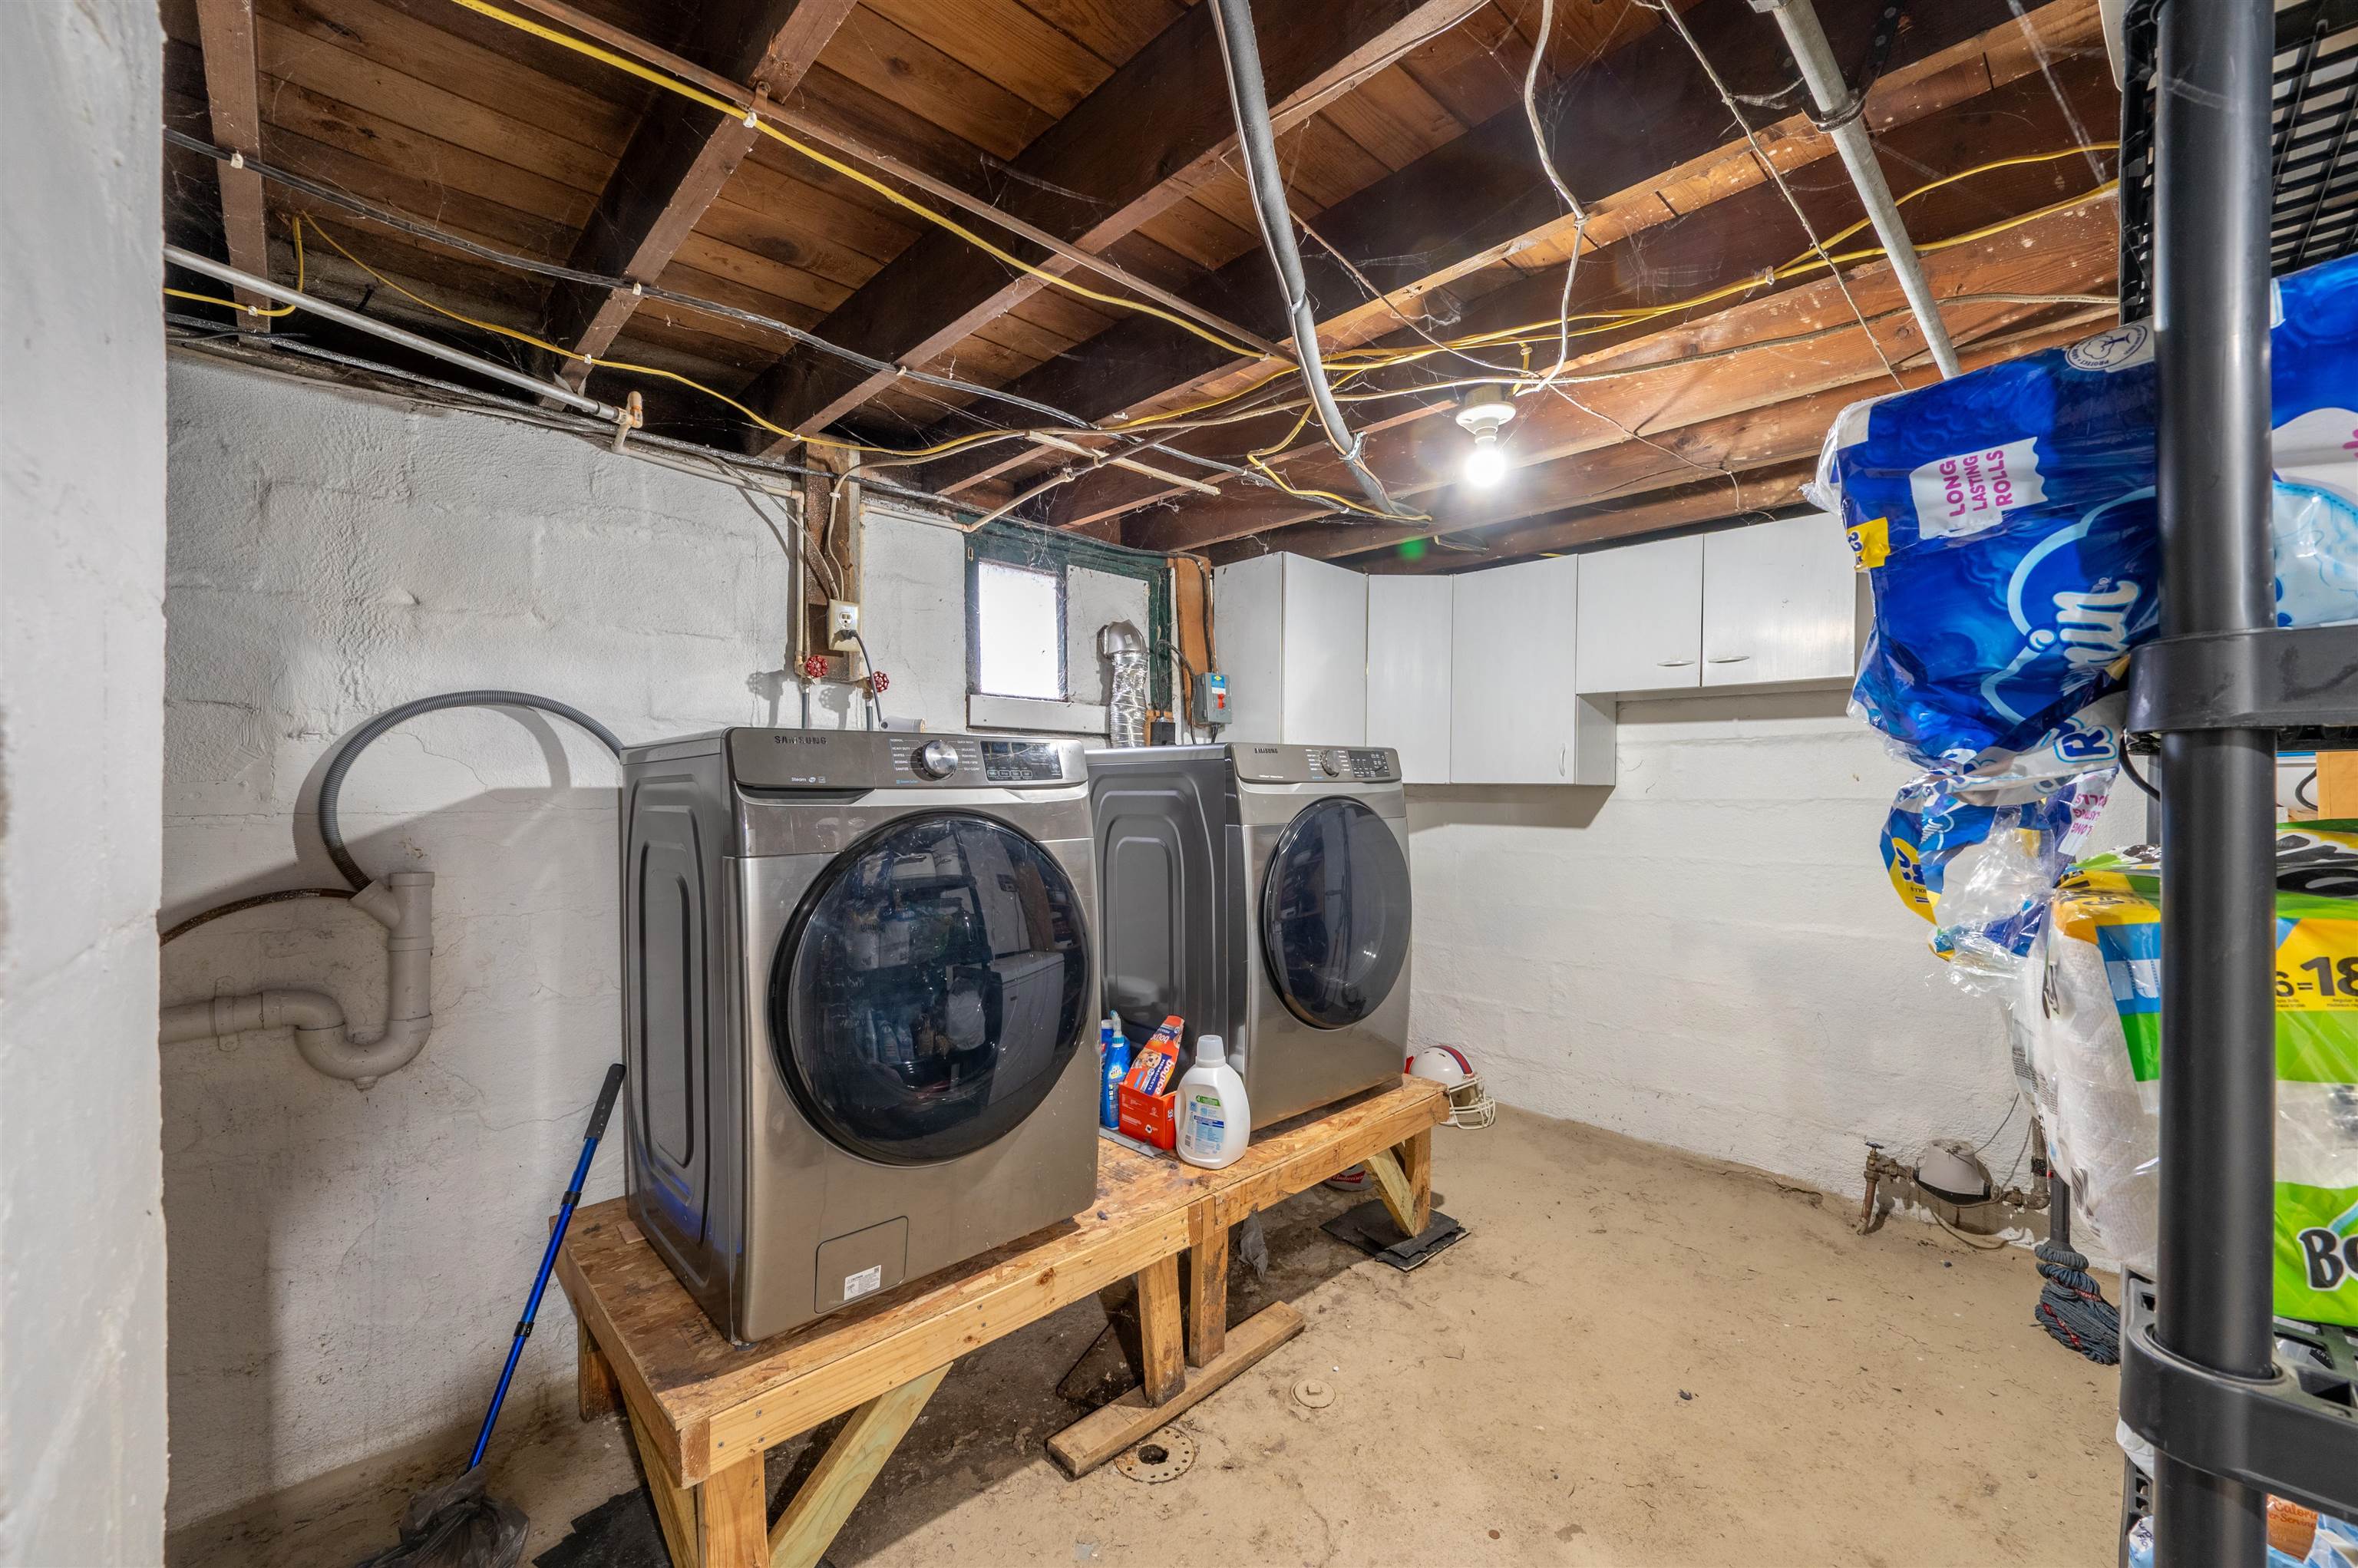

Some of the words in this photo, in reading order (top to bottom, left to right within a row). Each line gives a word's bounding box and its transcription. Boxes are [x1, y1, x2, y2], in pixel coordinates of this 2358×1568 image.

[1939, 460, 1966, 517] LONG
[1963, 455, 1988, 512] LASTING
[1986, 450, 2013, 507] ROLLS
[774, 735, 827, 744] SAMSUNG
[1155, 1058, 1174, 1094] bounce
